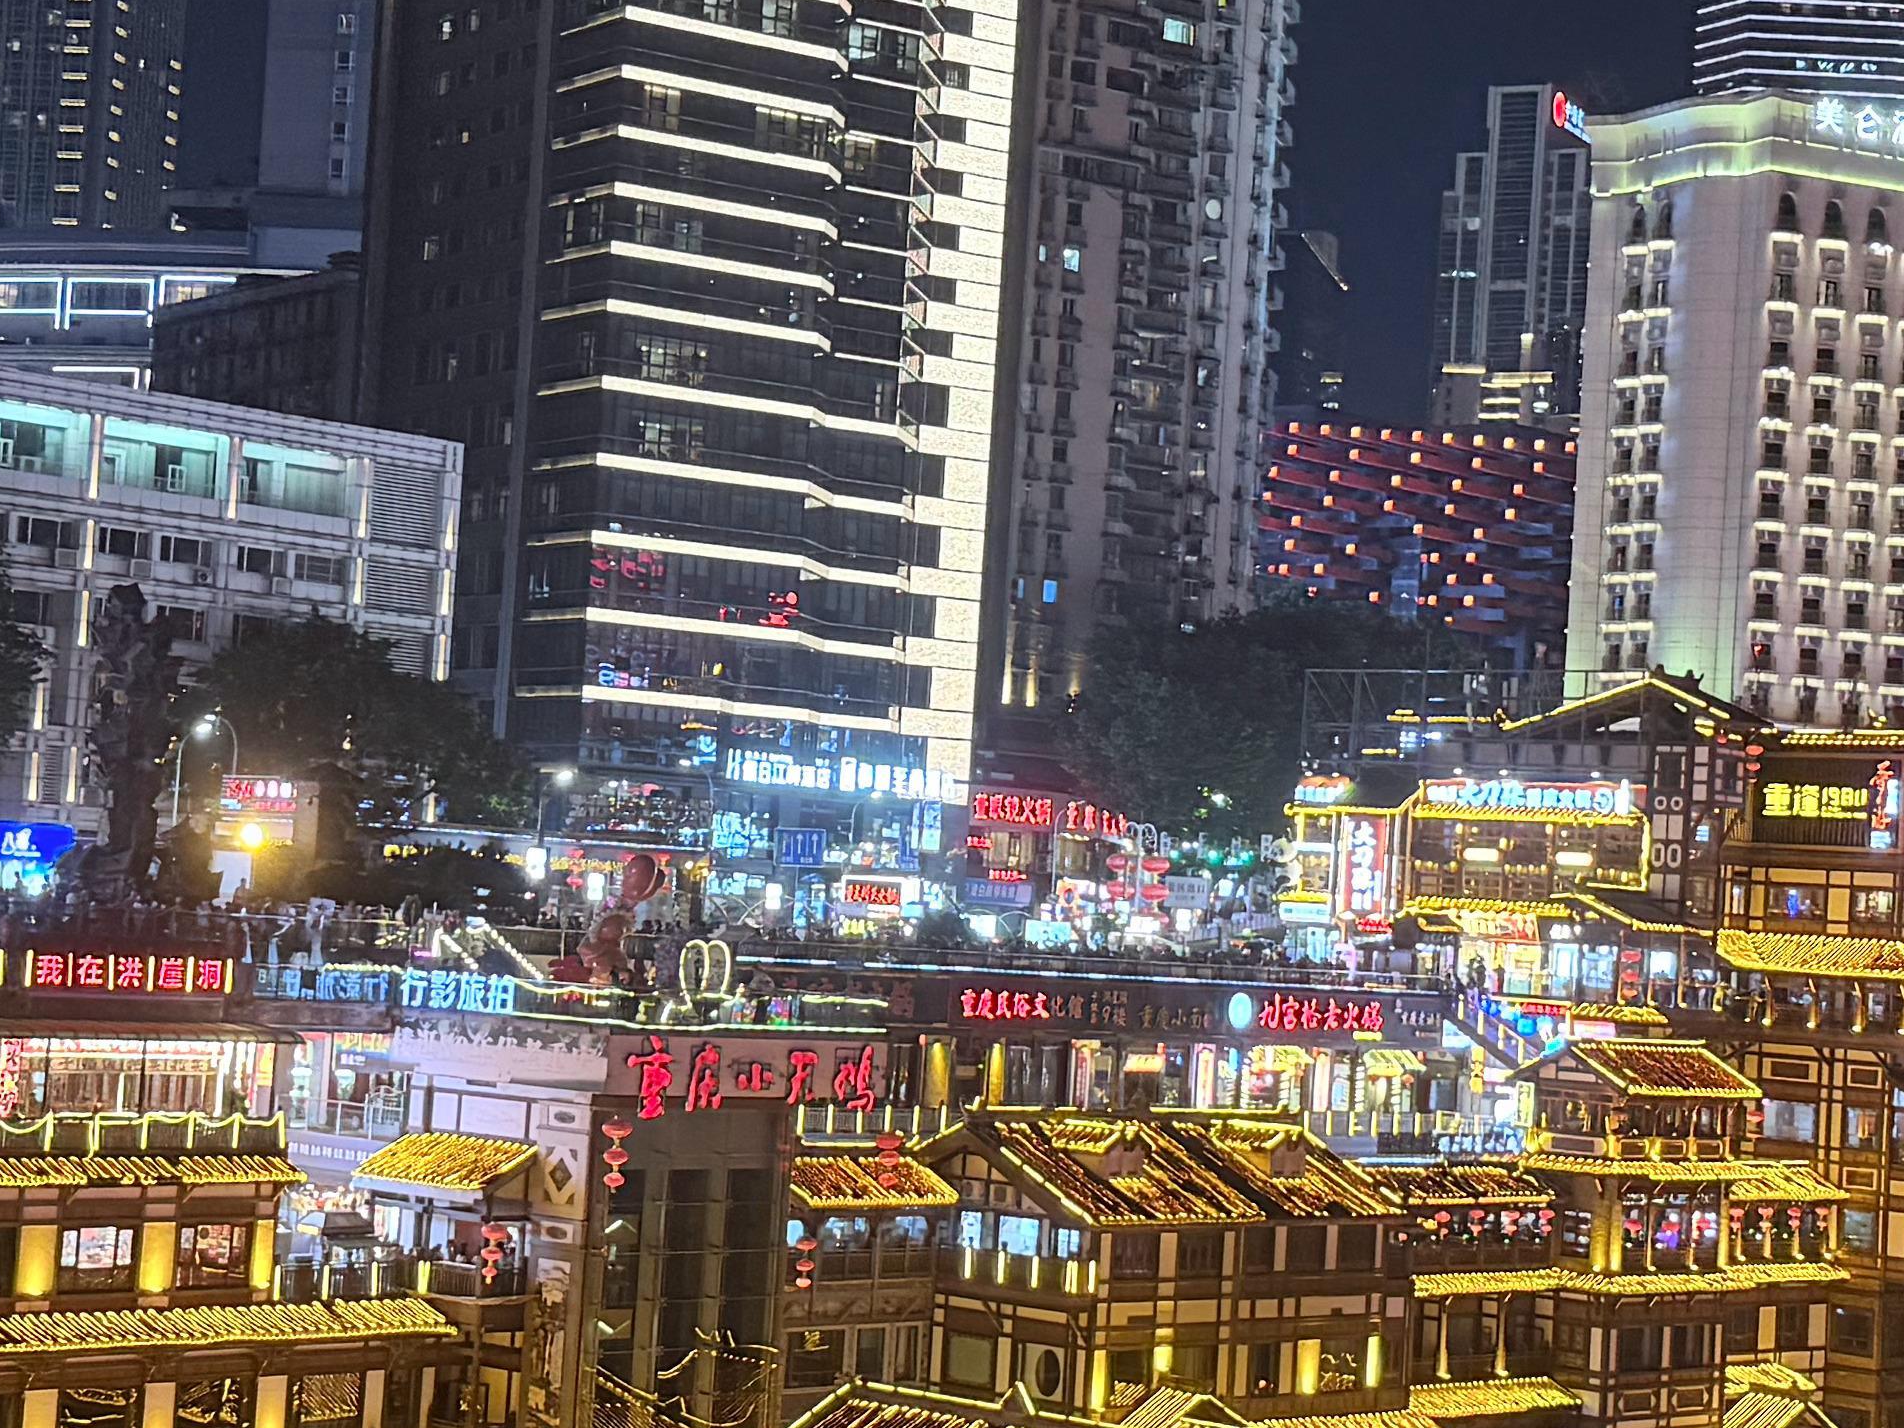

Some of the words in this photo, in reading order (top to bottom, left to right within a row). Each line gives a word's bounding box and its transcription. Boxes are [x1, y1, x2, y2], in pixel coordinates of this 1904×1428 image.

[36, 953, 225, 990] 我在洪崖洞
[400, 967, 515, 1015] 行影旅拍
[960, 988, 1084, 1020] 重庆民俗文化馆
[1258, 992, 1384, 1032] 九宫格老火锅
